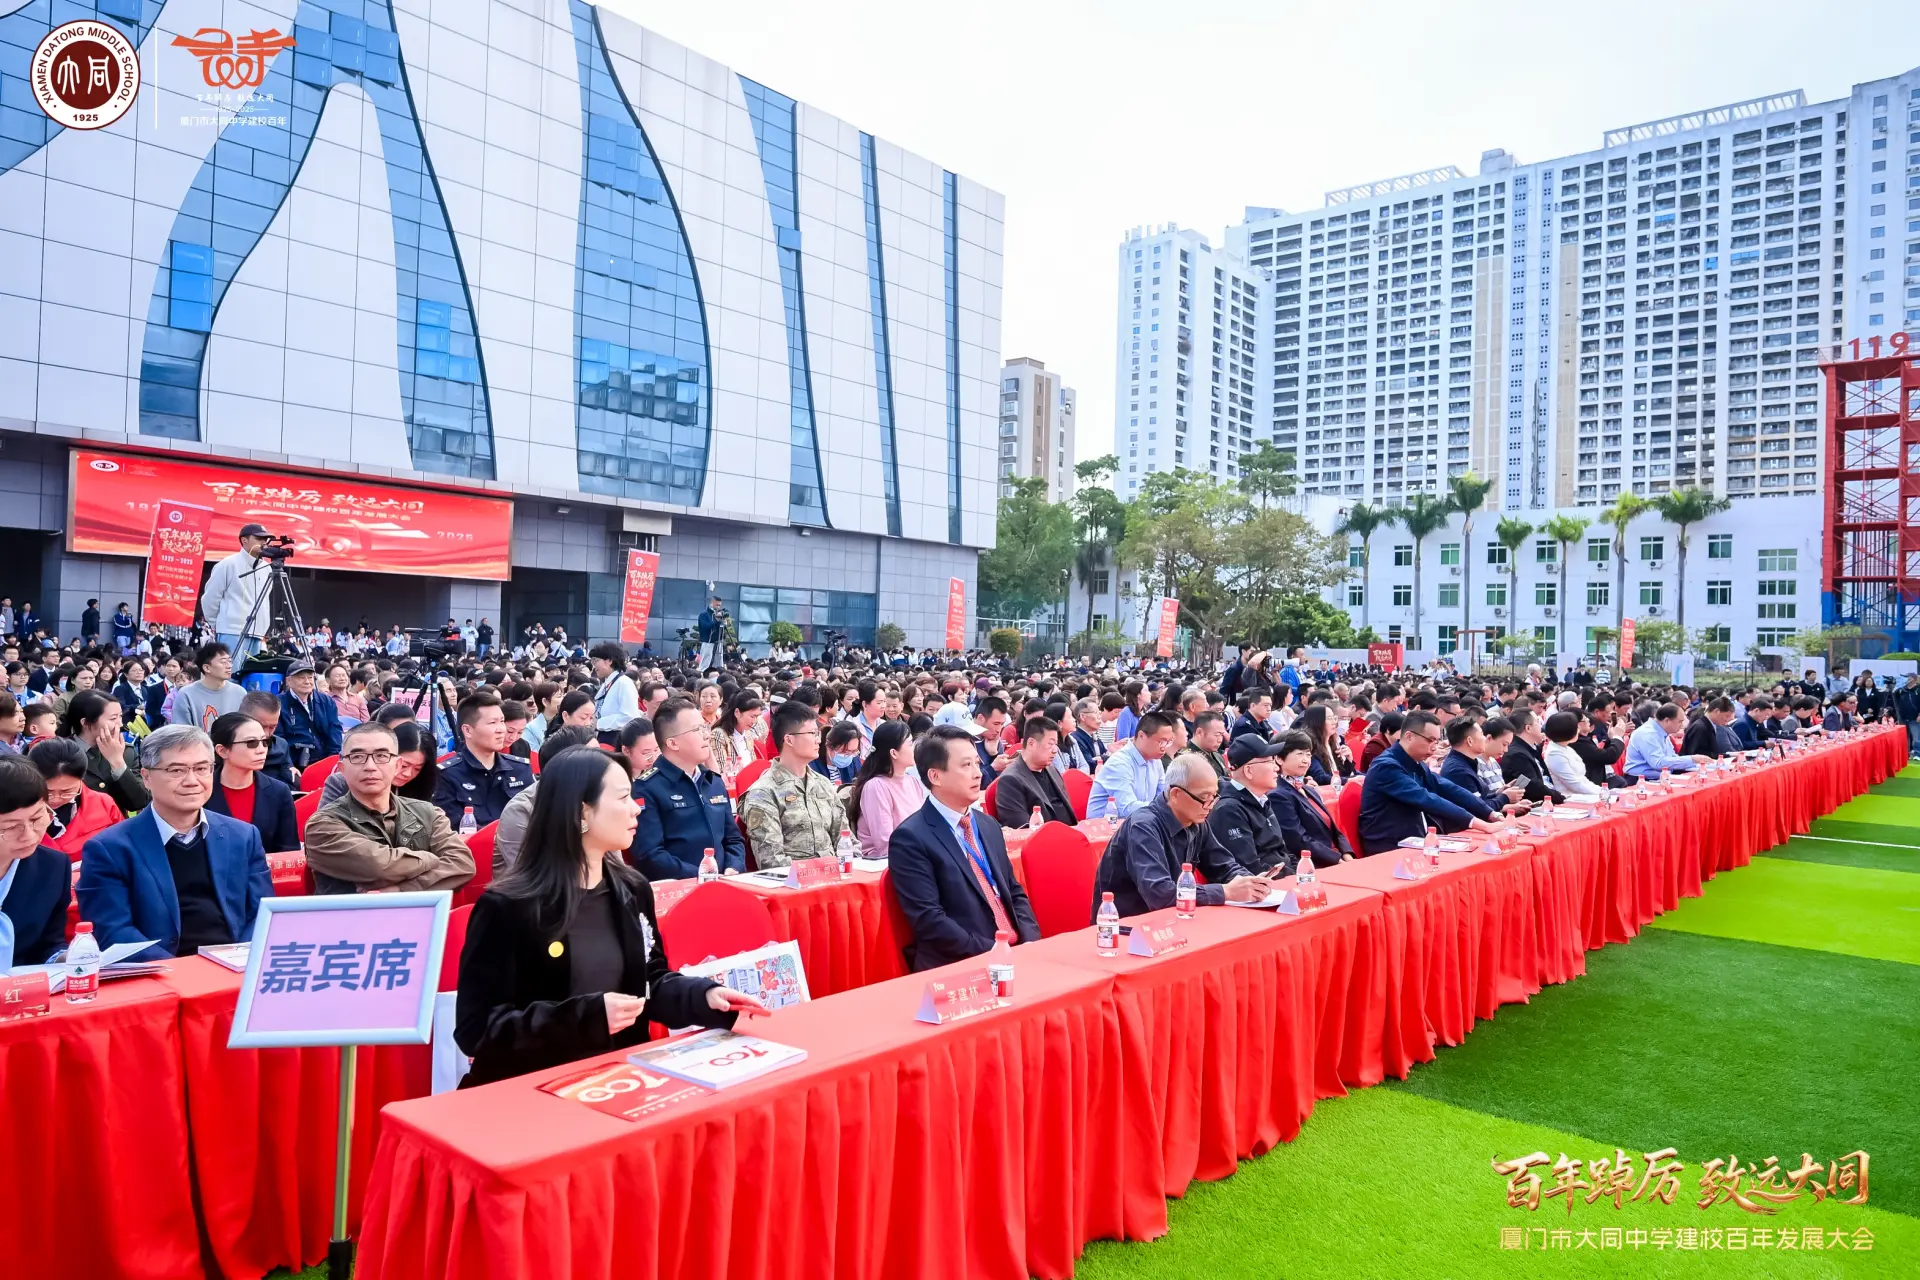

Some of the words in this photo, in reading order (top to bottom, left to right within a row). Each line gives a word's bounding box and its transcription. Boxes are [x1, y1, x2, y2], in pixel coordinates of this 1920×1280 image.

[1848, 331, 1911, 361] 119
[203, 480, 321, 504] 百年踔厉
[332, 494, 424, 513] 致远大同
[158, 527, 203, 543] 百年踔厉
[259, 938, 418, 995] 嘉宾席
